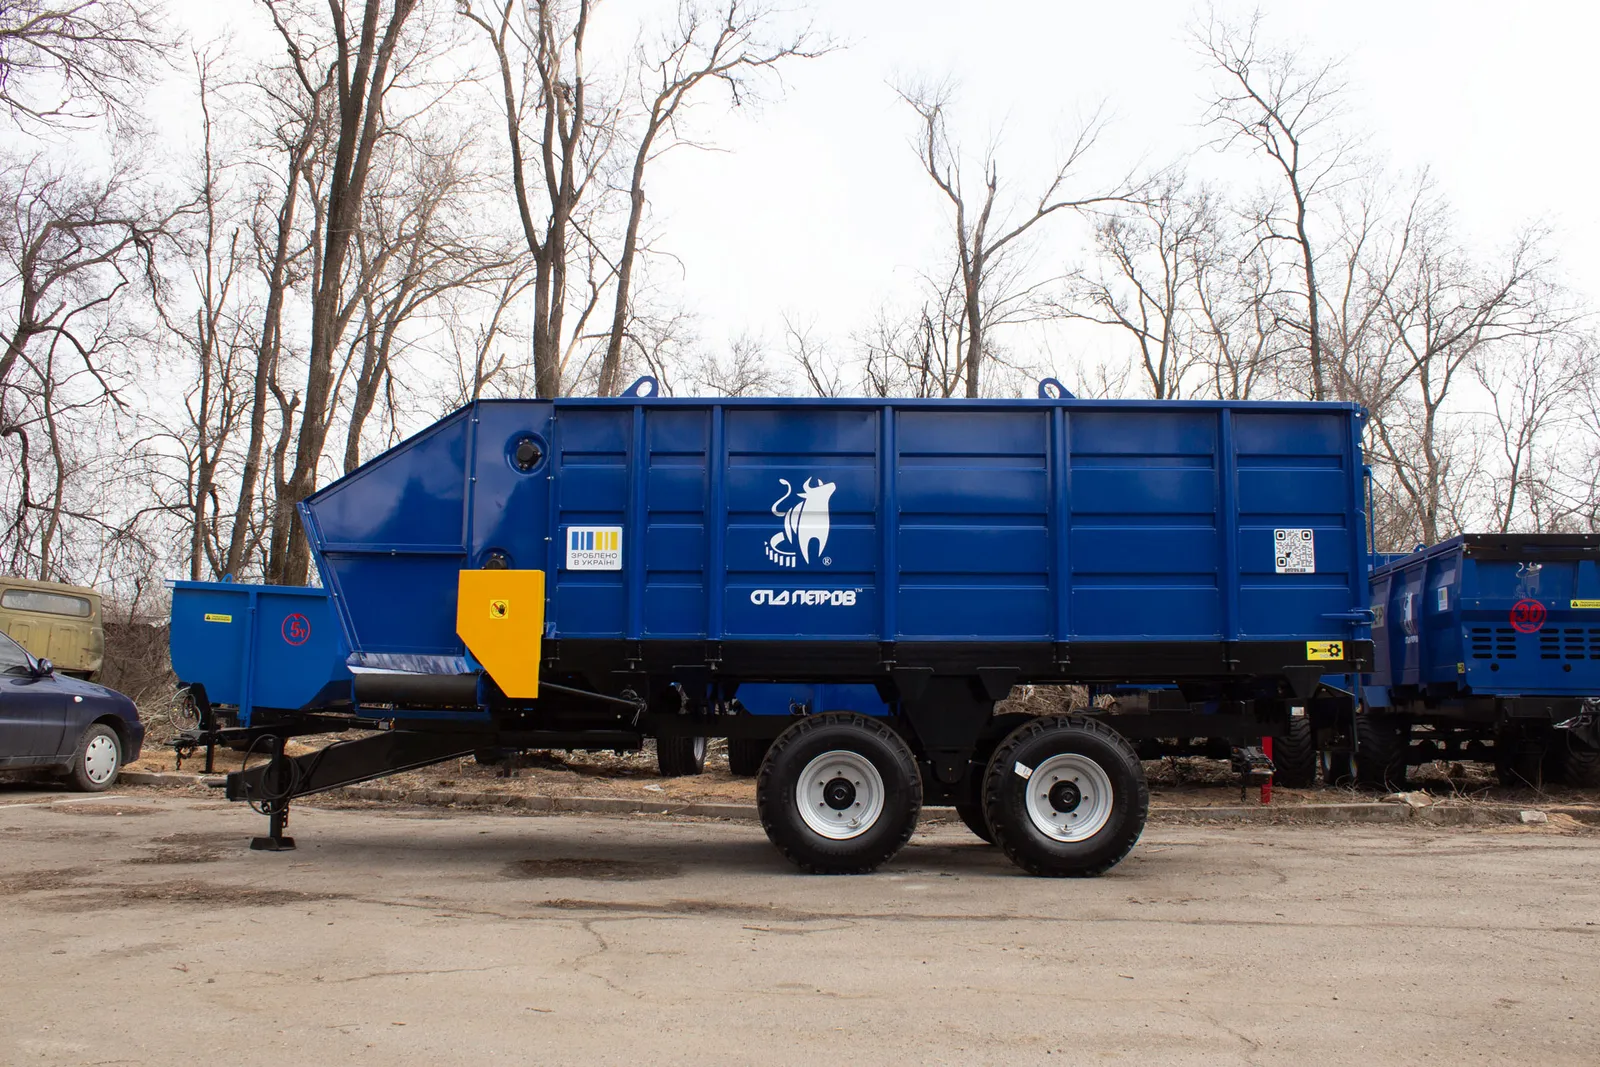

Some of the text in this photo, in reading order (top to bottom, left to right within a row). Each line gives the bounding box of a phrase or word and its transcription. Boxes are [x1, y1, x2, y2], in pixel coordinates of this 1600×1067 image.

[582, 558, 615, 566] УКРАЇНІ
[750, 589, 790, 606] СПД
[791, 589, 857, 606] ПЕТРОВ
[1516, 603, 1542, 623] 30
